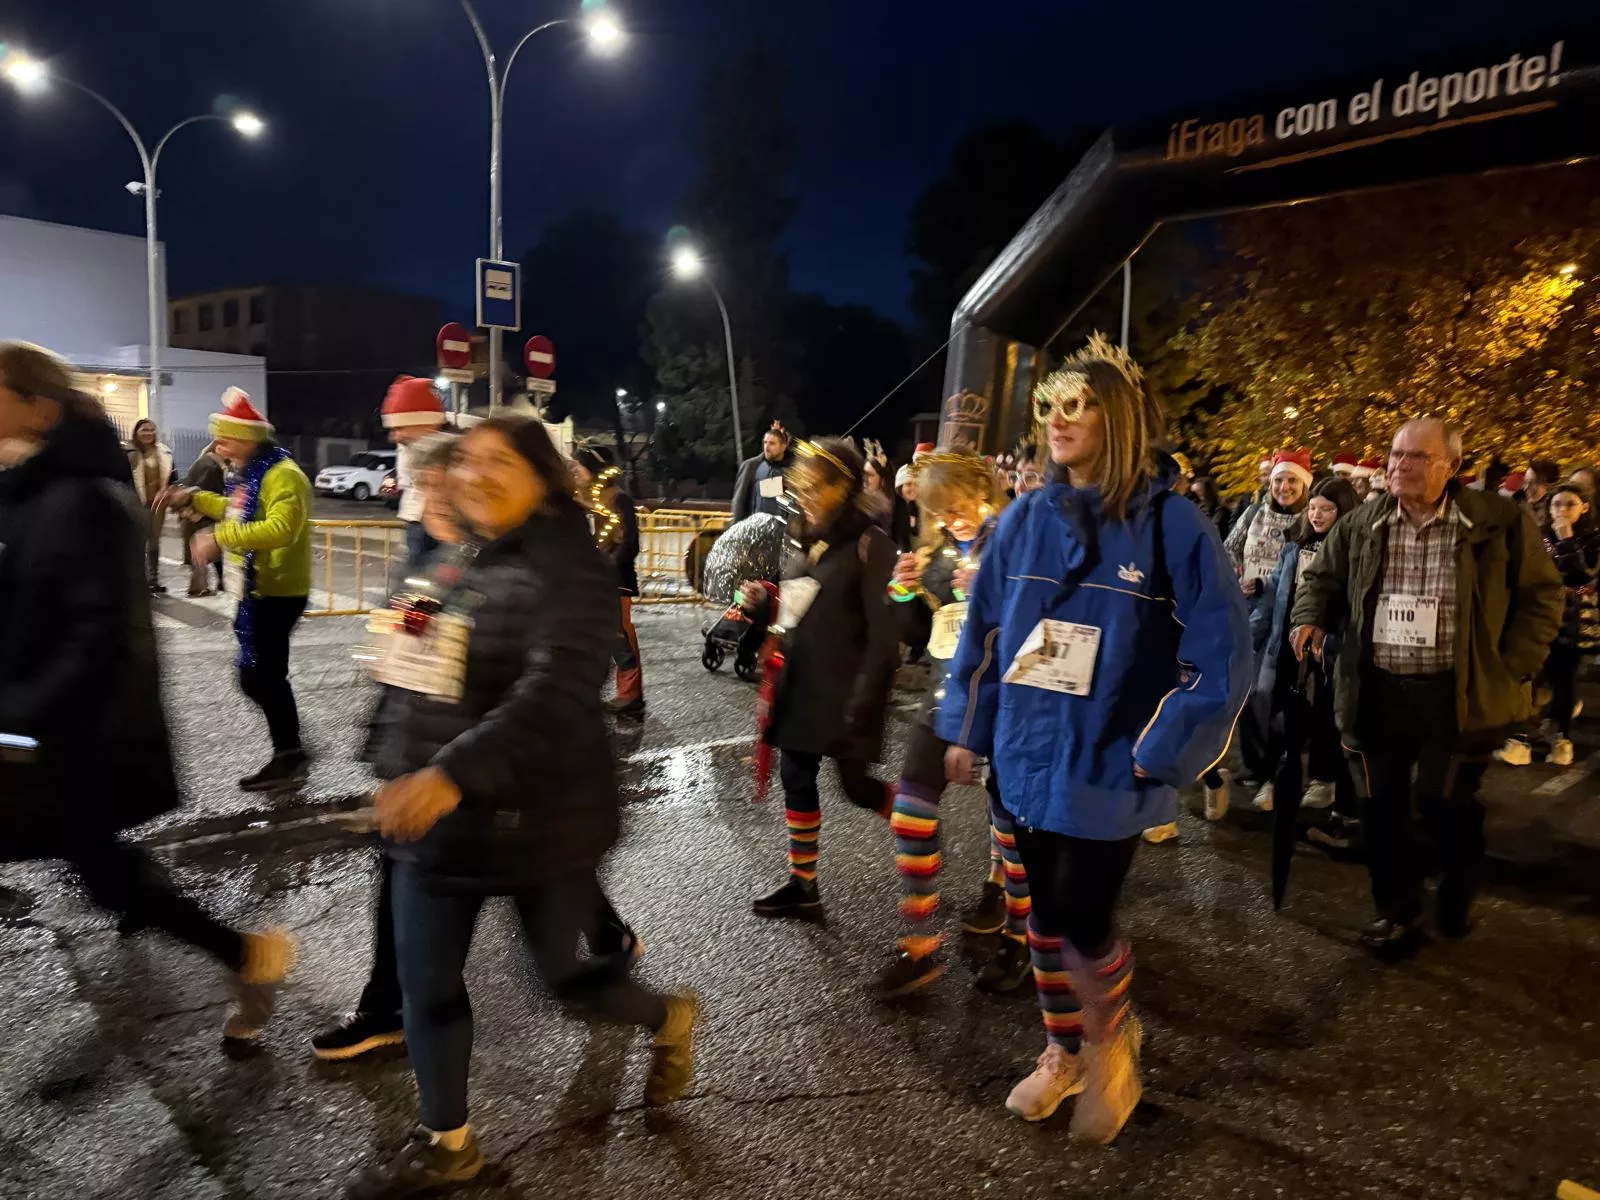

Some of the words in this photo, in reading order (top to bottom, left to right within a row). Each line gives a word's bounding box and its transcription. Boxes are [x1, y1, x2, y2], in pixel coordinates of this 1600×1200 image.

[1275, 98, 1337, 140] con
[1348, 78, 1384, 126] el
[1391, 40, 1565, 119] deporte!
[1388, 609, 1415, 622] 1110
